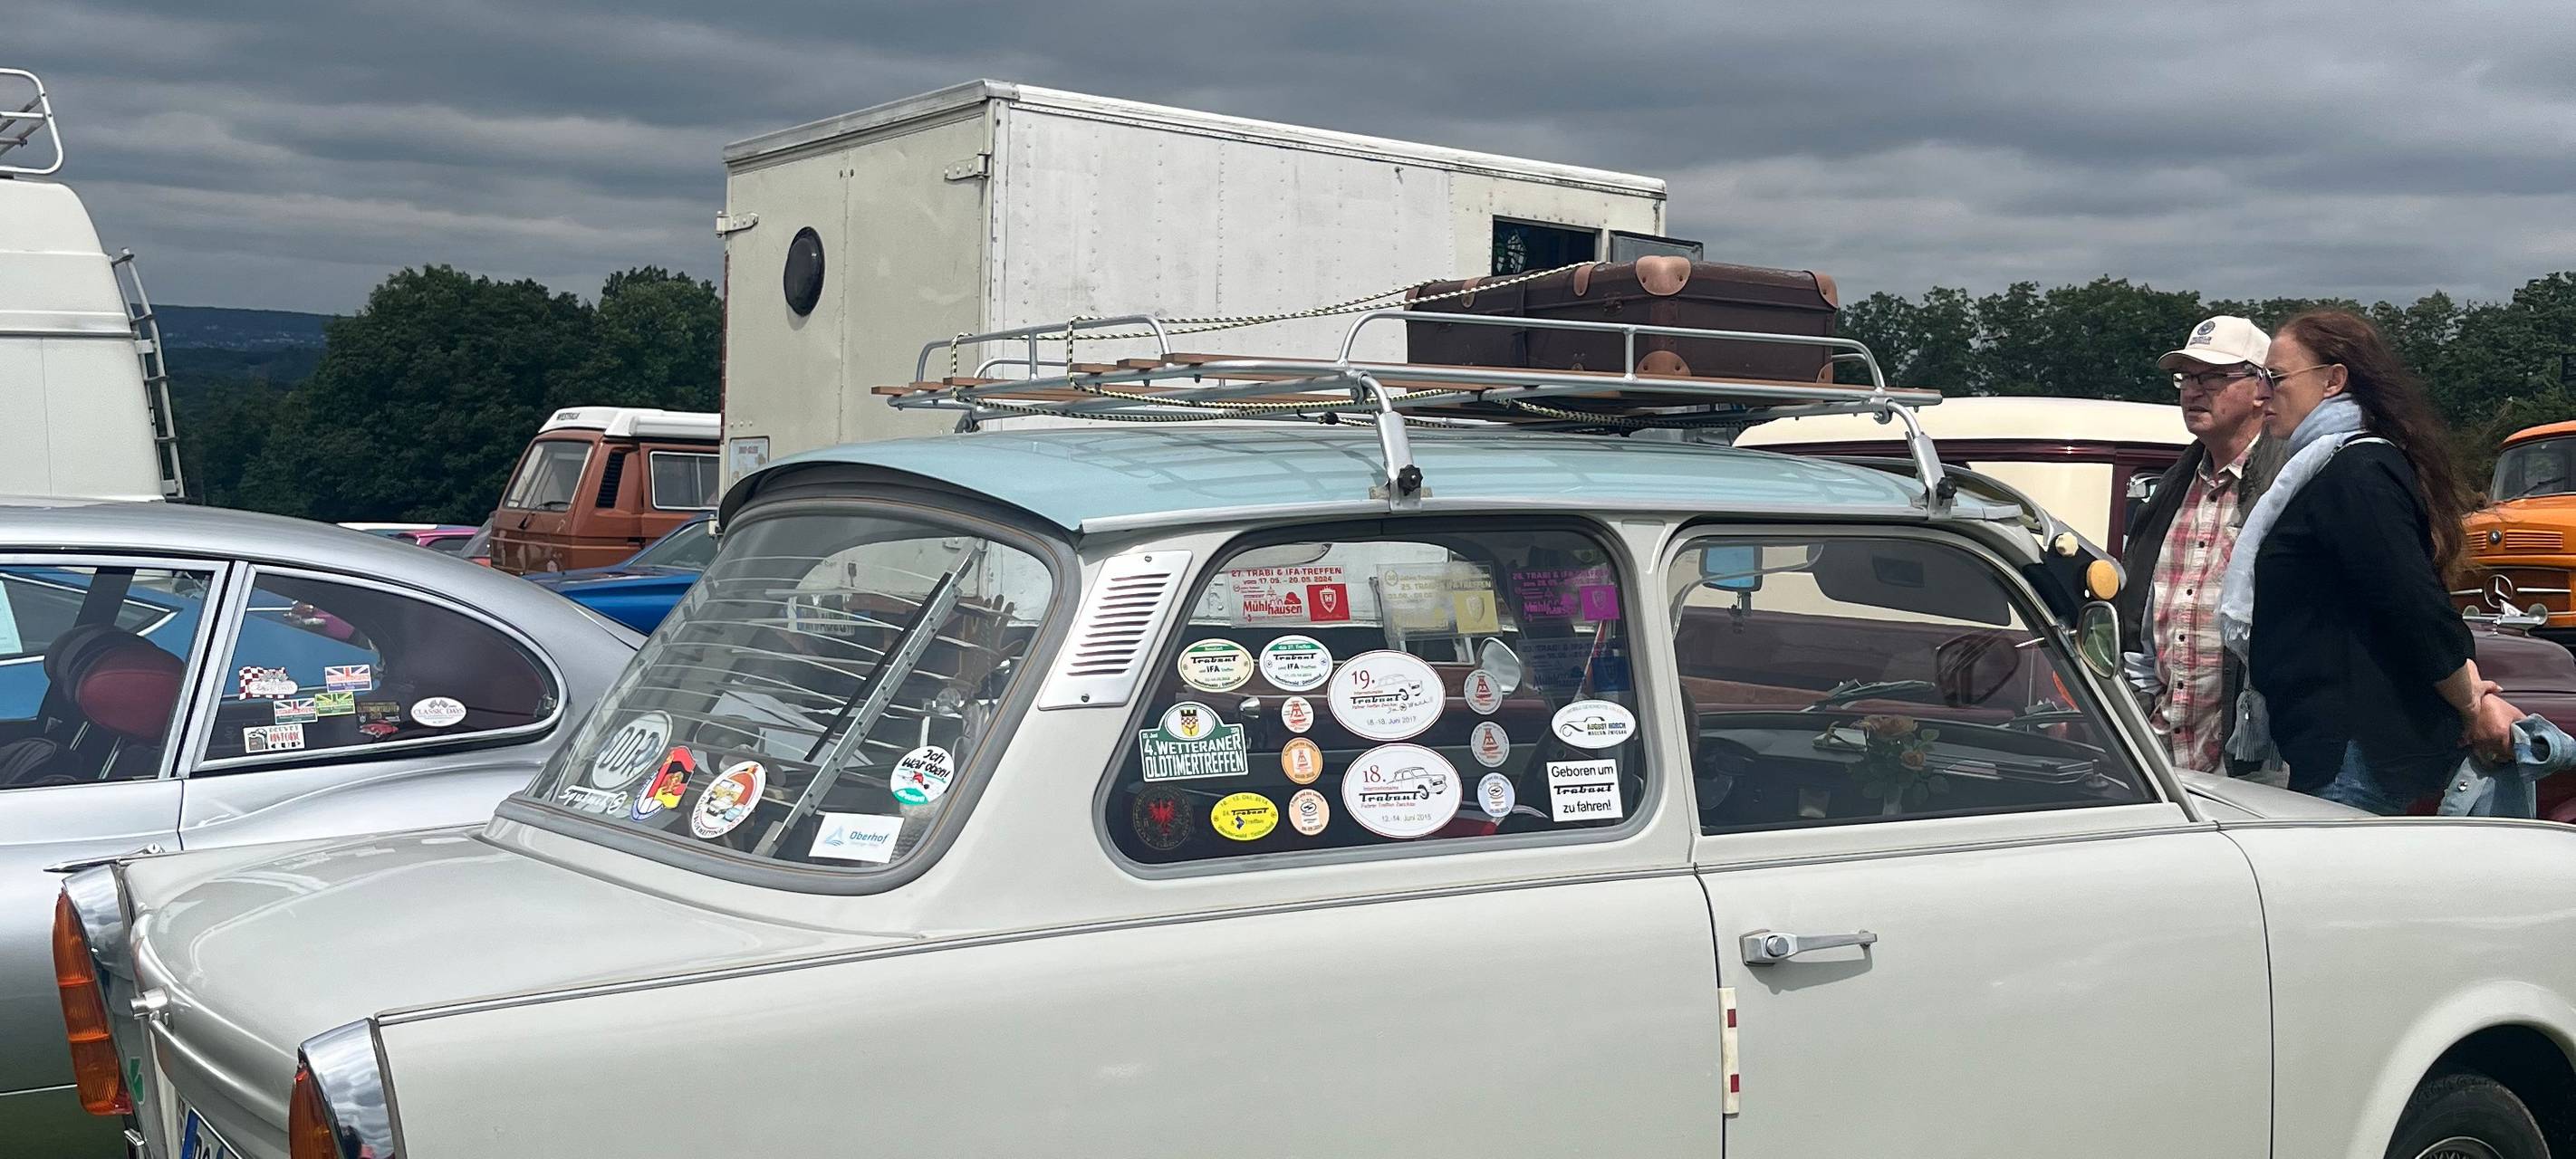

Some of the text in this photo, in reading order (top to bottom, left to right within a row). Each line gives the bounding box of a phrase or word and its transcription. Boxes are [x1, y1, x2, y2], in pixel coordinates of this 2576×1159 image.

[1247, 569, 1274, 577] TRABI
[1268, 604, 1302, 615] hausen
[1190, 654, 1240, 665] Trabant
[1274, 652, 1318, 662] Trabant
[1206, 665, 1221, 674] IFA
[1287, 663, 1300, 671] IFA
[1350, 670, 1376, 690] 19.
[1350, 693, 1403, 705] Trabant
[1388, 716, 1400, 724] Juni
[1401, 715, 1417, 723] 2017
[1156, 733, 1243, 755] WETTERANER
[923, 749, 946, 764] Ich
[1145, 750, 1245, 779] OLDTIMERTREFFEN
[1362, 764, 1387, 783] 18.
[1551, 765, 1614, 778] Geboren um
[1553, 781, 1615, 795] Trabant
[1359, 790, 1421, 803] Trabant
[1231, 807, 1270, 816] Trabant
[1563, 799, 1611, 813] zu fahren!
[849, 830, 890, 845] Oberhof
